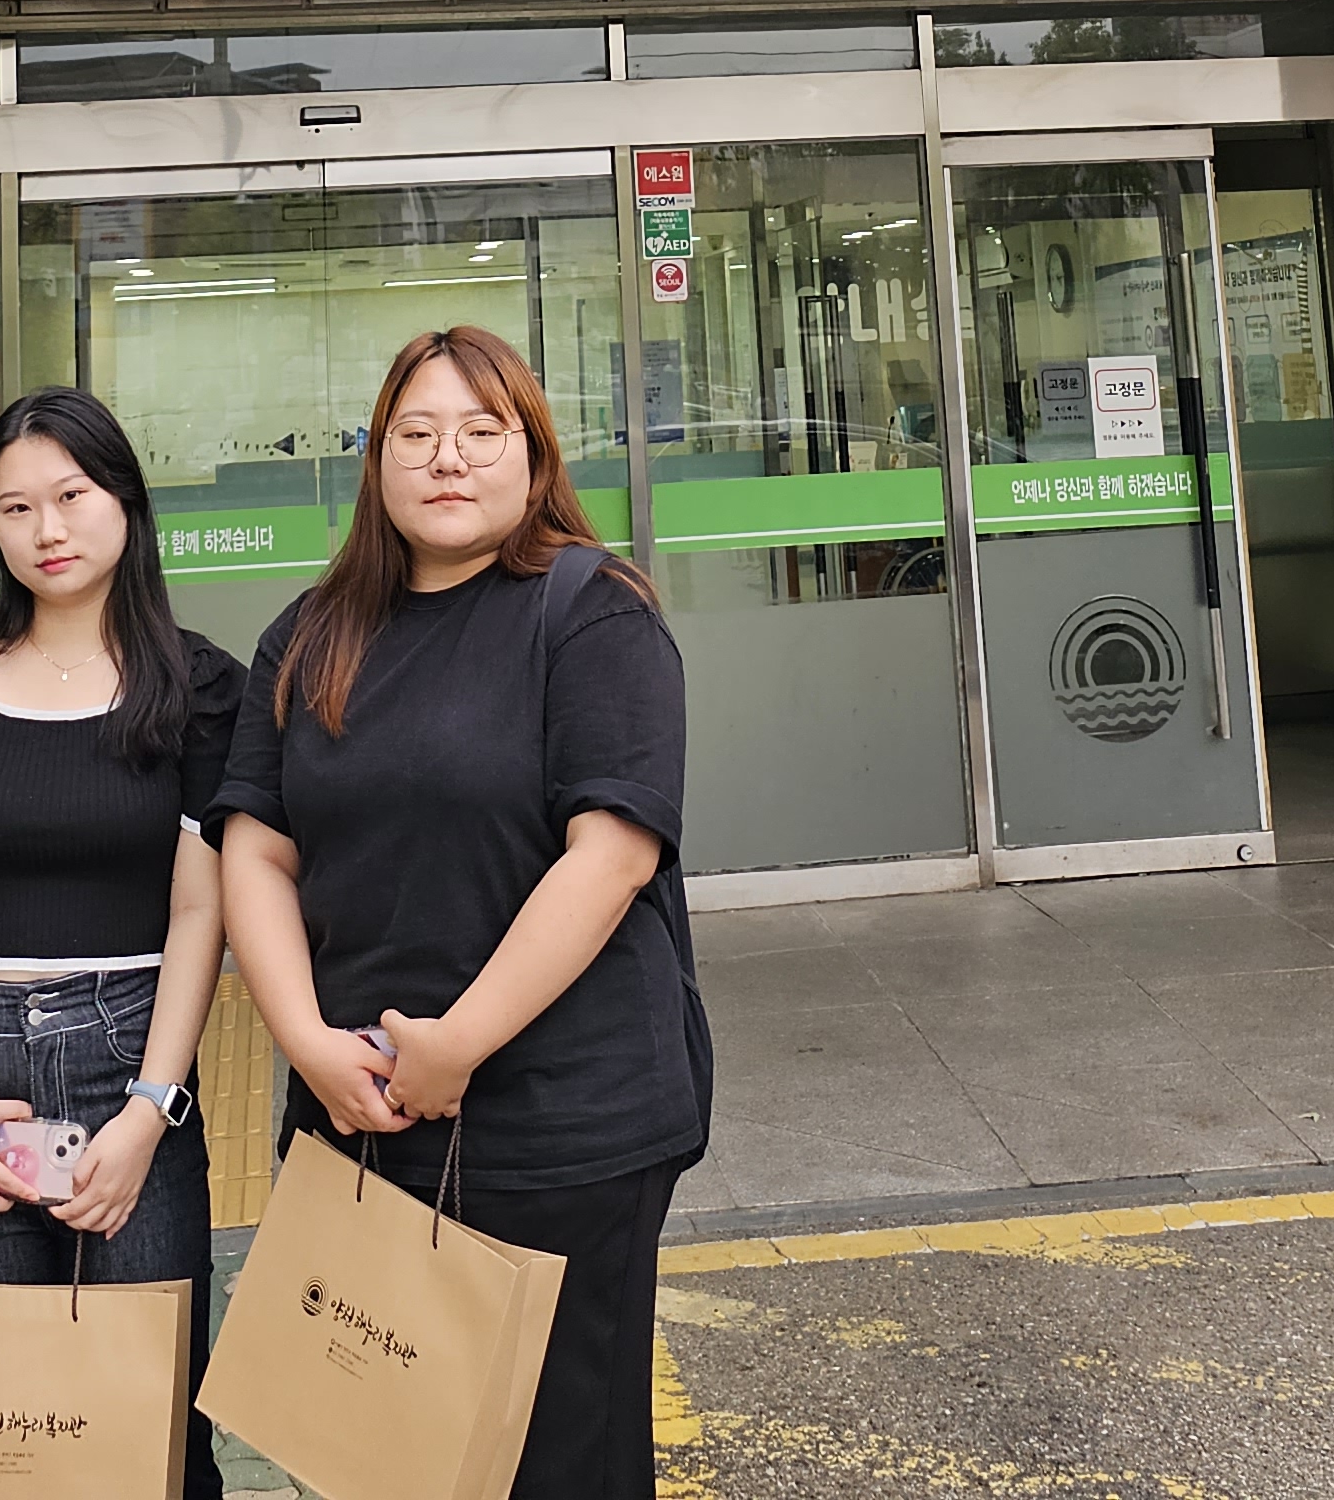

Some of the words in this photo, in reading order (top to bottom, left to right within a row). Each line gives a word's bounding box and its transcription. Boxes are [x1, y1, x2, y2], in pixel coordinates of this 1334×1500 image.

[643, 165, 684, 183] 에스원
[639, 196, 676, 208] SECOM
[664, 239, 690, 251] AED
[658, 277, 682, 287] SEOUL
[1104, 380, 1147, 398] 고정문
[1011, 478, 1051, 504] 언제나
[1054, 475, 1095, 502] 당신과
[1097, 474, 1125, 499] 함께
[1127, 471, 1193, 498] 하겠습니다
[170, 529, 200, 556] 함께
[203, 524, 274, 555] 하겠습니다
